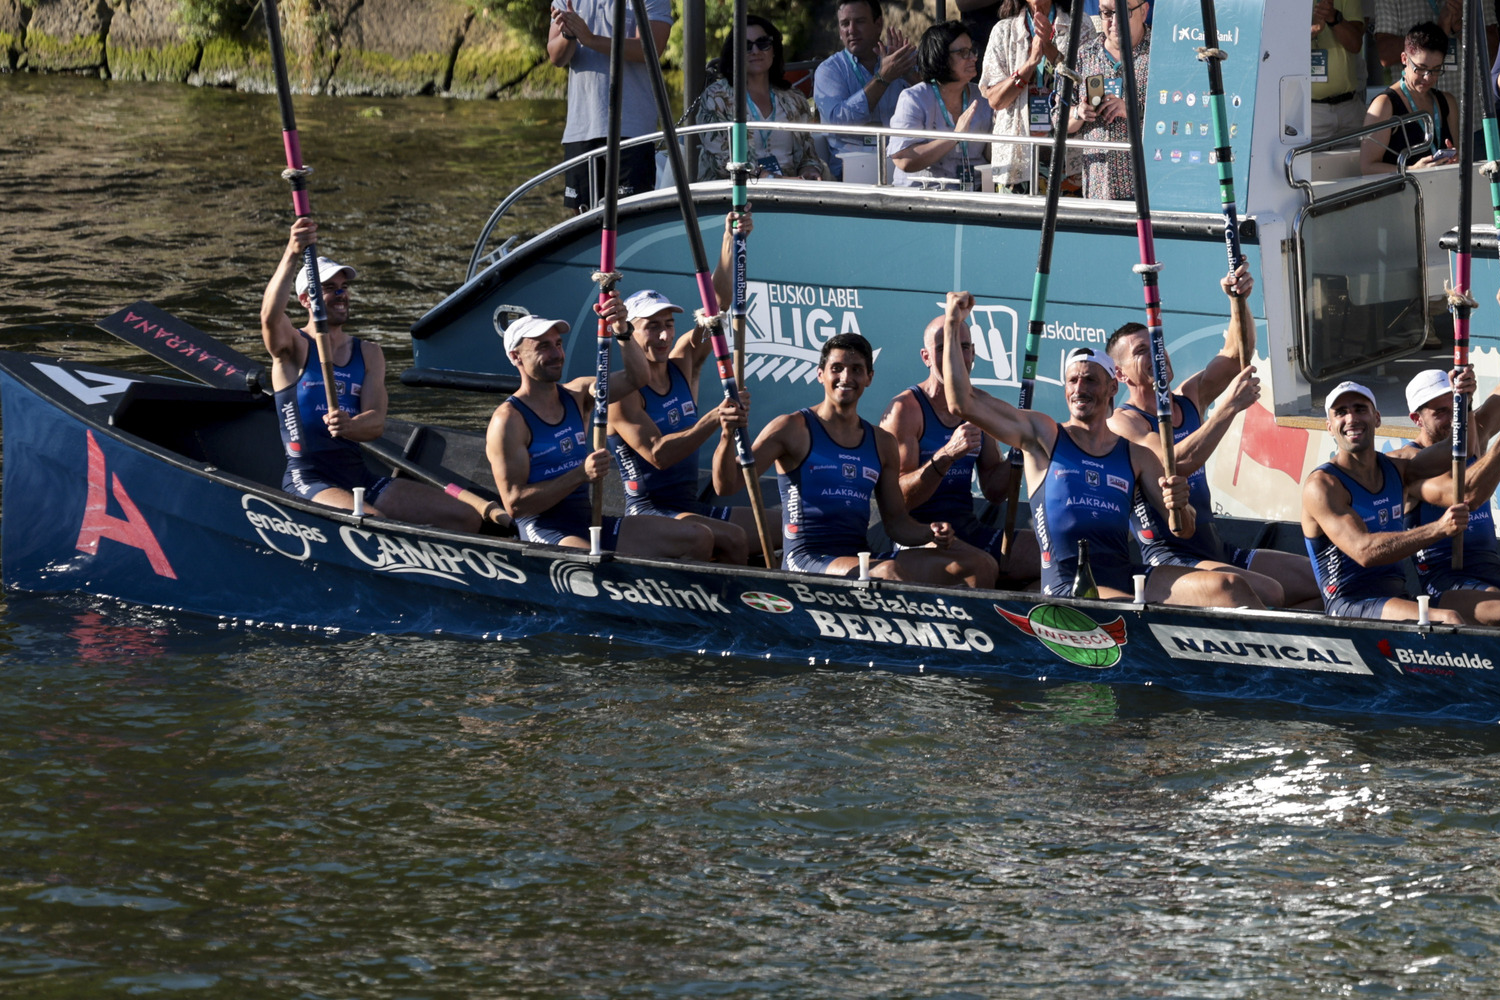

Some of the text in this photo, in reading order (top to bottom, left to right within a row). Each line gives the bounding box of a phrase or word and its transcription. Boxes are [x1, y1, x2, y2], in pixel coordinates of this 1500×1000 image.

[737, 254, 746, 306] CaixaBank
[770, 284, 863, 309] EUSKO LABEL
[122, 310, 243, 378] ALAKRANA
[769, 306, 862, 351] LIGA
[1041, 321, 1106, 343] uskotren
[597, 348, 609, 399] CaixaBank
[720, 365, 726, 374] 5
[1026, 365, 1031, 374] 5
[1154, 336, 1166, 389] CaixaBank
[281, 401, 299, 442] satlink
[1452, 393, 1463, 447] CaixaBank
[615, 445, 641, 480] satlink
[790, 484, 799, 524] satlink
[821, 487, 868, 501] ALAKRANA
[1066, 496, 1121, 514] ALAKRANA
[246, 508, 327, 546] enagas
[1035, 504, 1048, 551] satlink
[339, 525, 528, 584] CAMPOS
[604, 579, 732, 615] satlink
[788, 582, 973, 622] Bou Bizkaia
[806, 608, 994, 653] BERMEO
[1036, 625, 1112, 647] INPESCA
[1171, 636, 1353, 666] NAUTICAL
[1396, 649, 1494, 670] Bizkaialde
